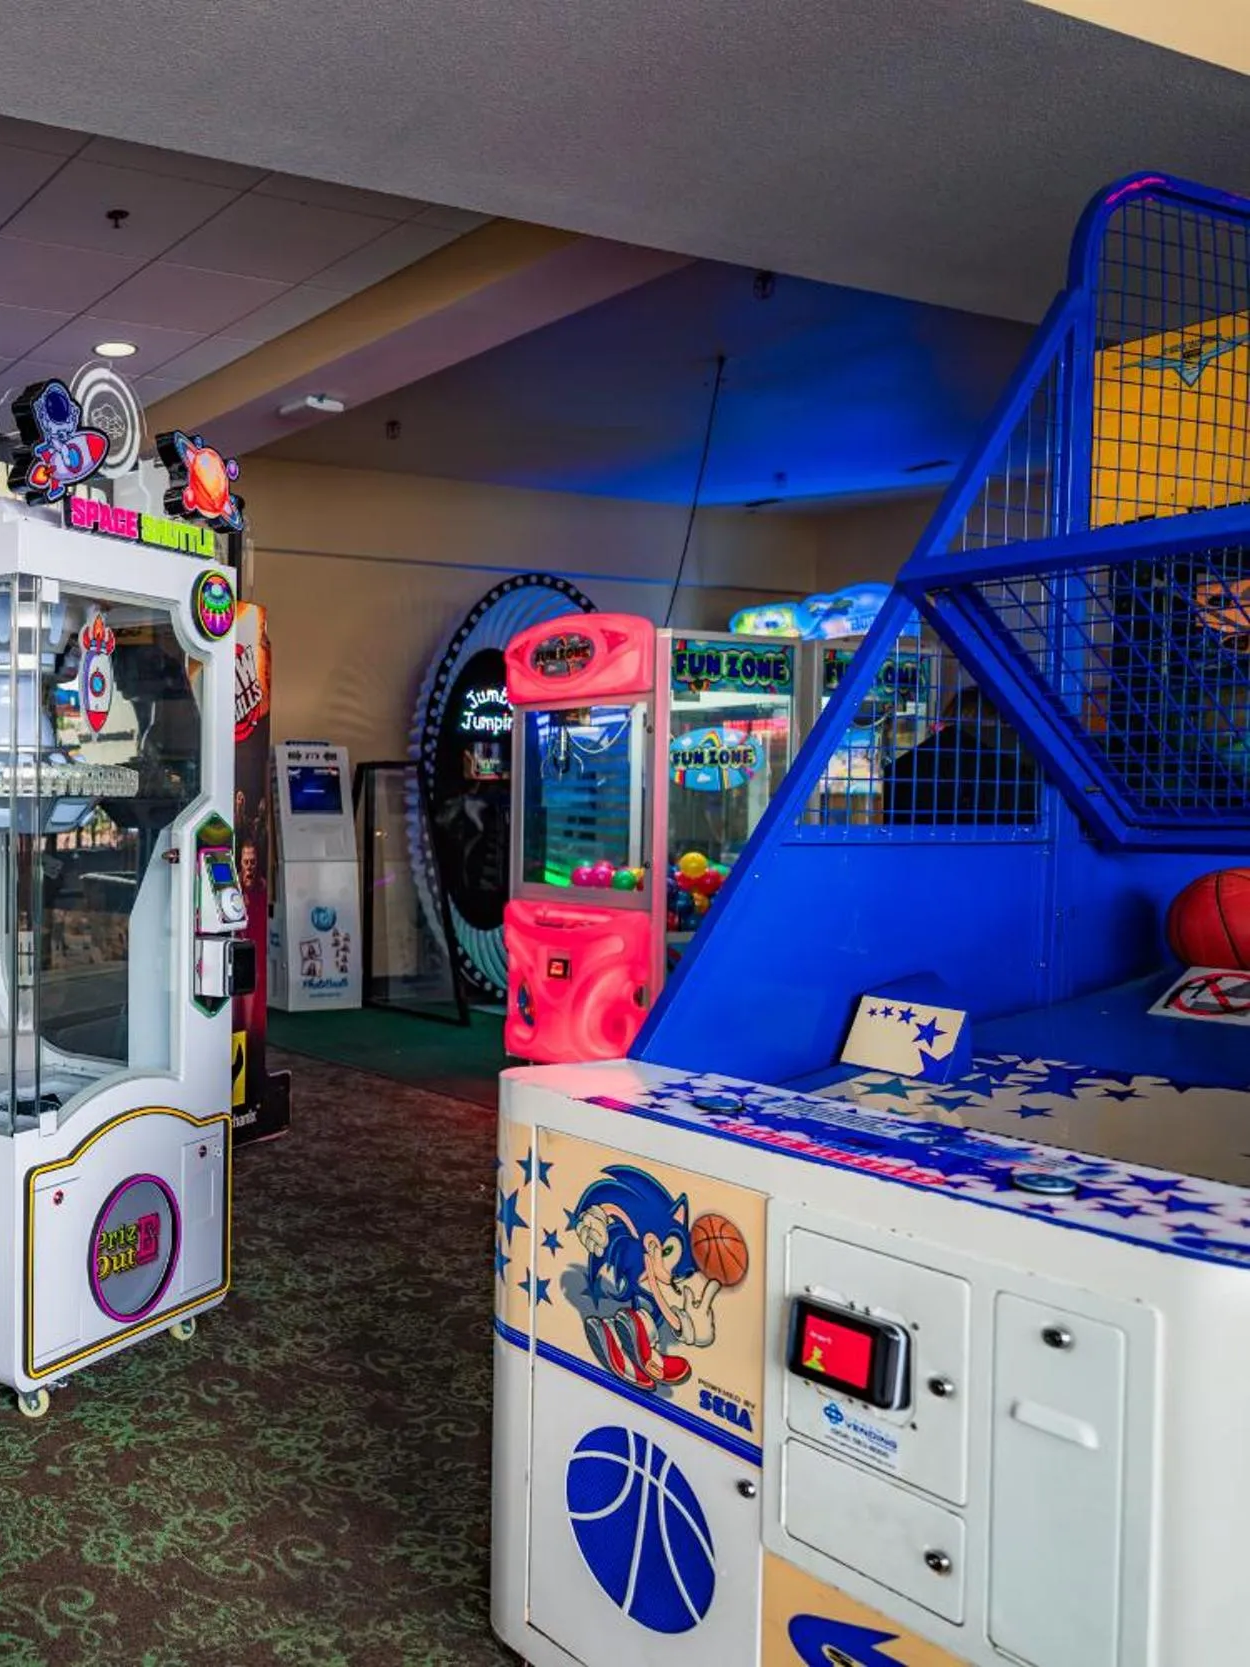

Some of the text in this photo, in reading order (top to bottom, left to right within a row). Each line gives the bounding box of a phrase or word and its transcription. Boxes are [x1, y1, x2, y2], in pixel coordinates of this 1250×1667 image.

[70, 496, 215, 557] SPACE SHUTTLE
[674, 651, 788, 683] FUN ZONE
[672, 745, 754, 767] FUN ZONE
[699, 1389, 753, 1432] SEGA
[846, 1421, 898, 1449] VENDING
